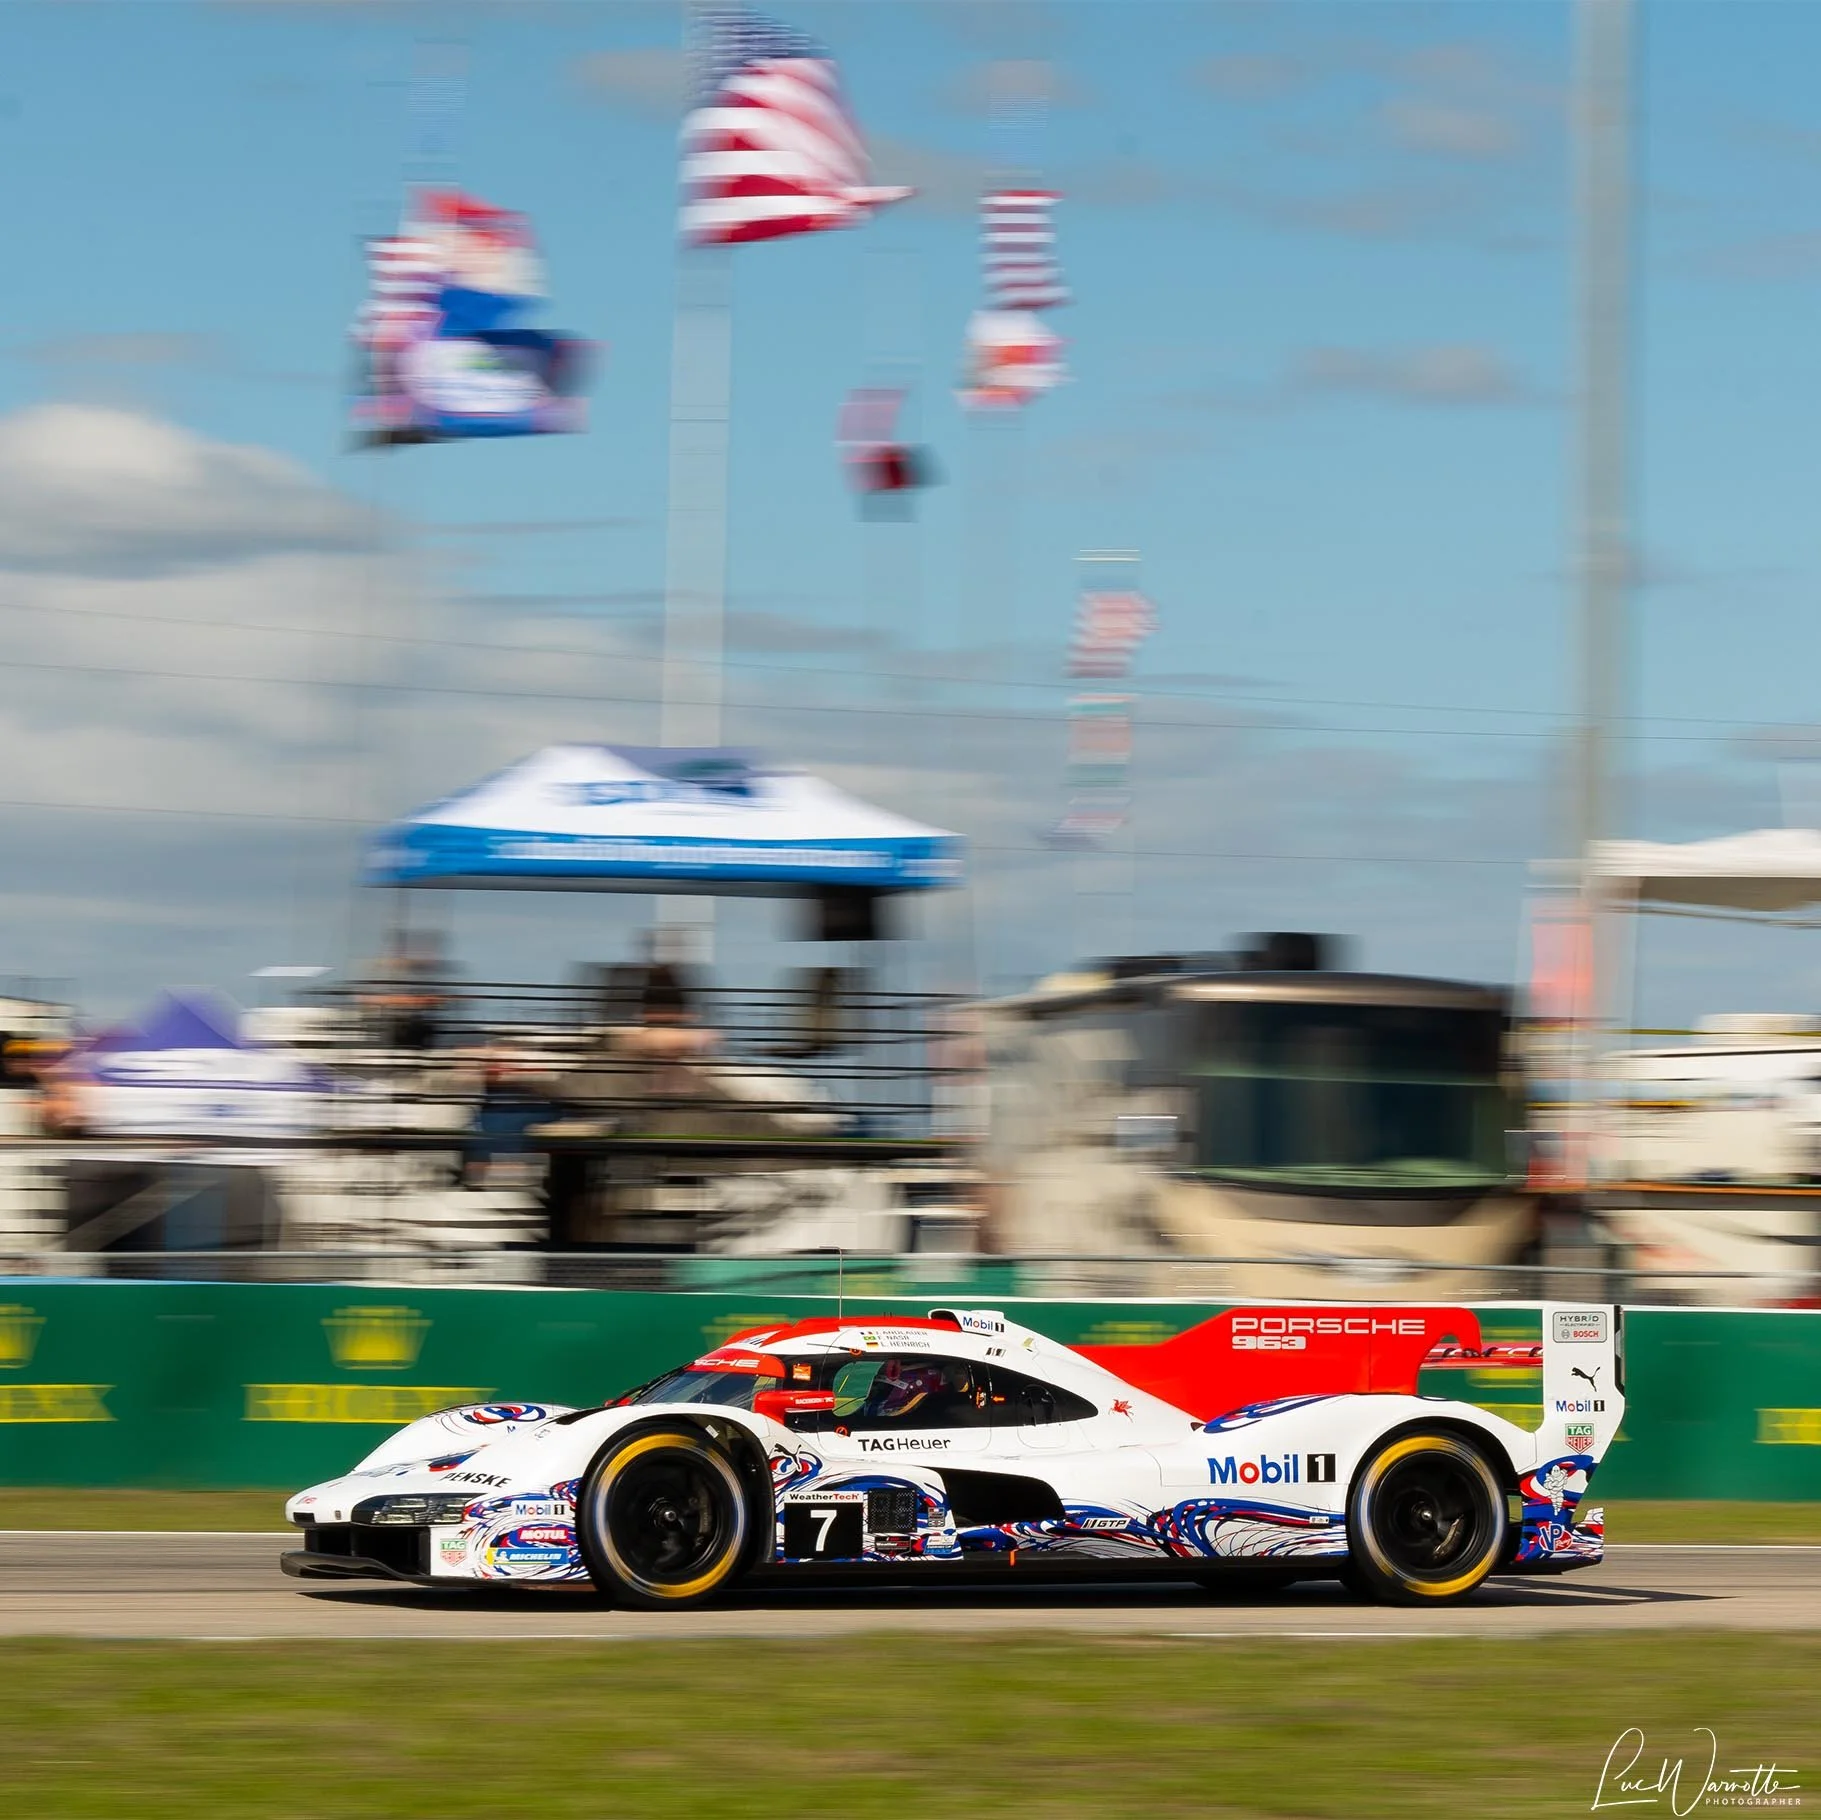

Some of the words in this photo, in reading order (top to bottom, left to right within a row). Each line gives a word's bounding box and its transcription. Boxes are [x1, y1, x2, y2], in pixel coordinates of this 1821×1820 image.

[963, 1316, 993, 1331] Mobil
[1560, 1314, 1599, 1322] HYBRID
[1232, 1317, 1425, 1335] PORSCHE
[1573, 1330, 1599, 1338] BOSCH
[1232, 1335, 1306, 1350] 963
[1556, 1400, 1591, 1412] Mobil
[1569, 1426, 1591, 1435] TAG
[1568, 1436, 1592, 1451] HEUER
[1207, 1453, 1299, 1484] Mobil
[439, 1472, 512, 1488] PENSKE
[789, 1493, 858, 1501] WeatherTech
[515, 1504, 550, 1516] Mobil
[1097, 1520, 1126, 1528] GTP
[519, 1529, 567, 1541] MOTUL
[810, 1509, 838, 1552] 7
[1540, 1523, 1565, 1552] VP
[441, 1541, 466, 1549] TAG
[509, 1553, 562, 1561] MICHELIN
